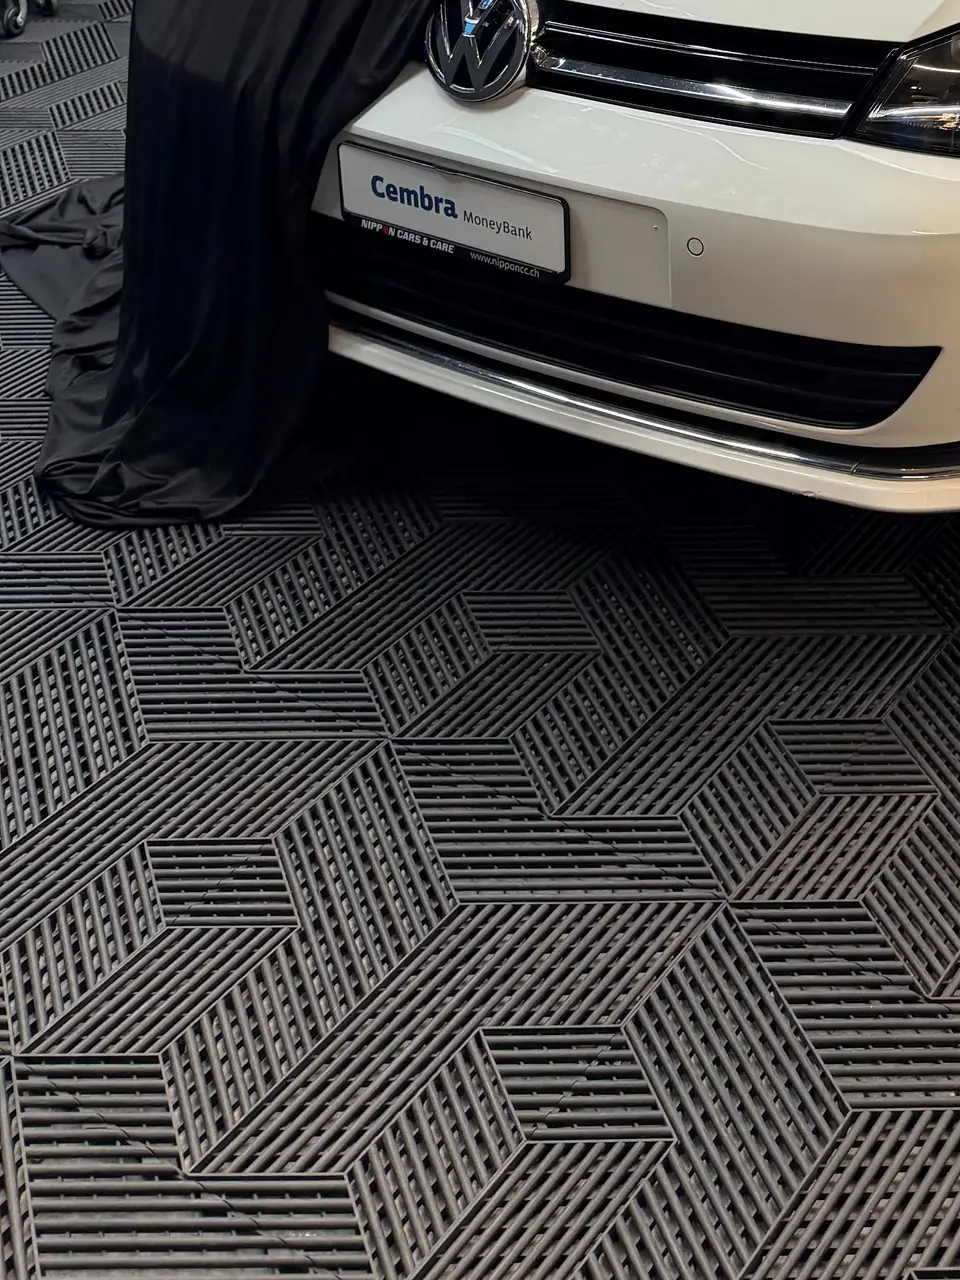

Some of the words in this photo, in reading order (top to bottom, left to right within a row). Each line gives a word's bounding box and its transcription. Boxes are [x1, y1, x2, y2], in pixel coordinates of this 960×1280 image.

[371, 175, 459, 219] Cembra
[463, 210, 534, 241] MoneyBank
[361, 218, 396, 238] NIPPON
[396, 229, 421, 245] CARS
[422, 236, 429, 247] &
[430, 238, 455, 255] CARE
[469, 251, 541, 279] www.nipponcc.ch
